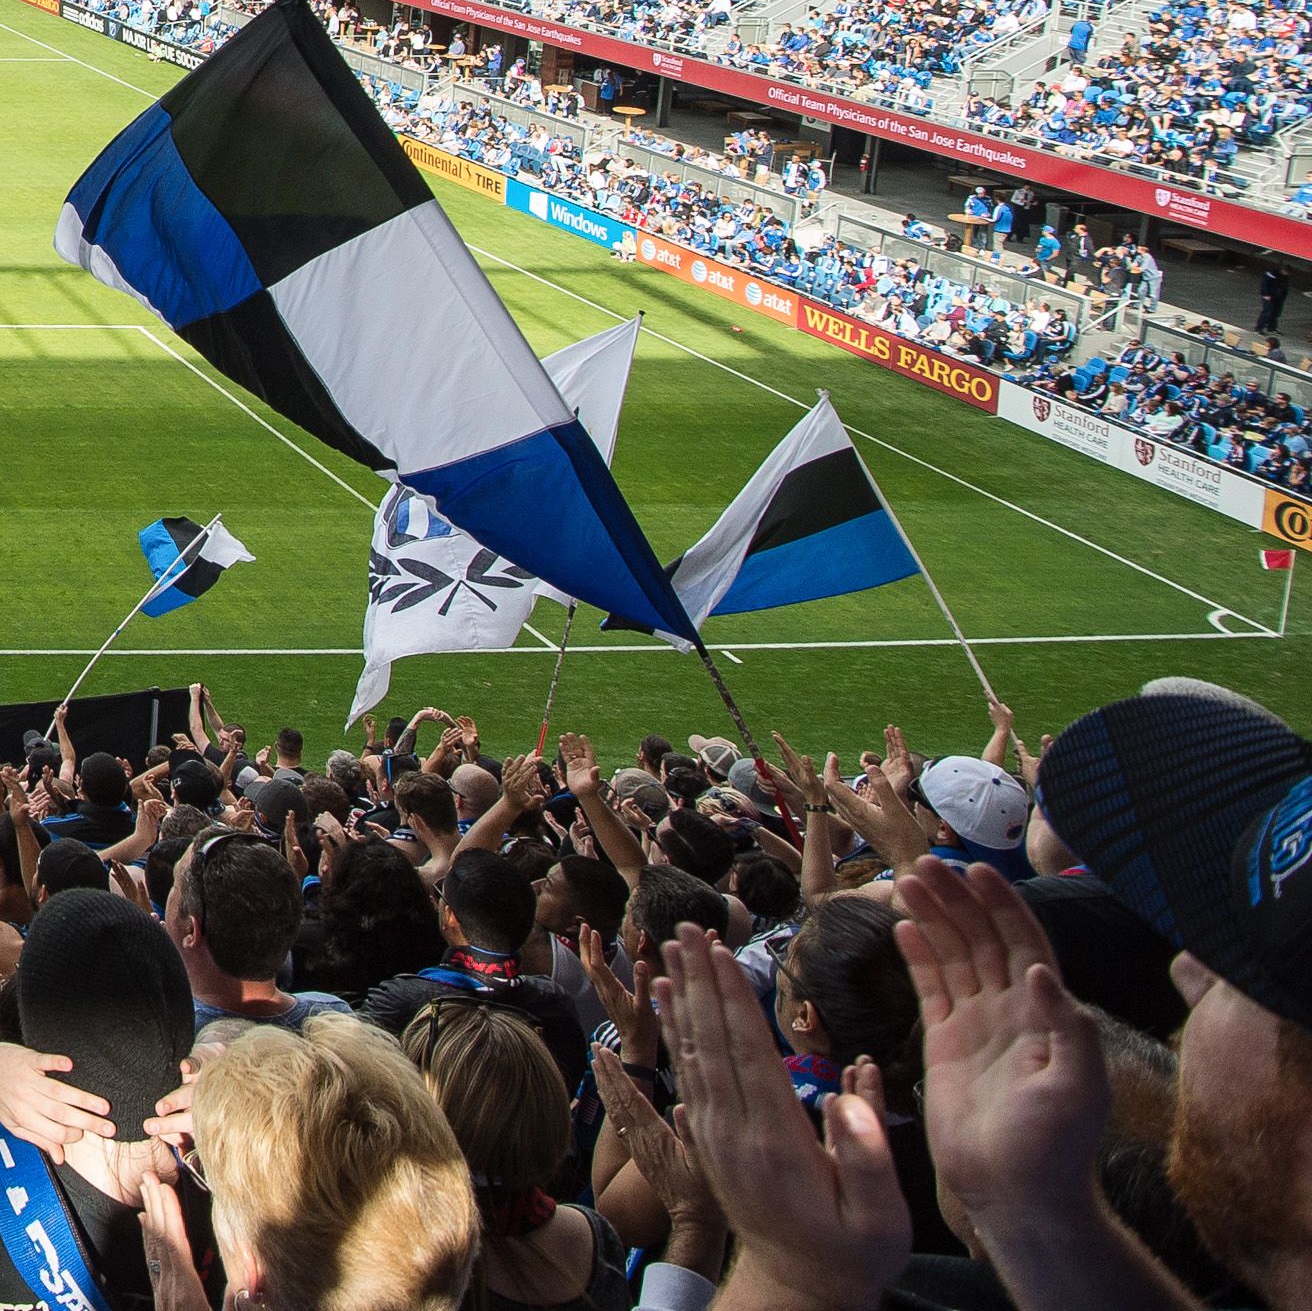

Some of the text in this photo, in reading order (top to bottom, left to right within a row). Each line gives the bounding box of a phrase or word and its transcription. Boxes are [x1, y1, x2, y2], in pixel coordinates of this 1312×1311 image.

[78, 11, 105, 34] adidas
[450, 0, 466, 15] Team
[466, 5, 496, 25] Physicians
[496, 13, 504, 25] of
[503, 15, 514, 27] the
[514, 17, 526, 31] San
[526, 21, 541, 35] Jose
[541, 26, 582, 47] Earthquakes
[122, 27, 147, 51] MAJOR
[768, 86, 1027, 169] Official Team Physicians of the San Jose Earthquakes
[475, 172, 502, 195] TIRE
[550, 201, 608, 241] Windows
[657, 247, 682, 270] at&t
[708, 269, 735, 293] at&t
[763, 291, 792, 316] at&t
[803, 304, 993, 403] WELLS FARGO
[1053, 419, 1109, 450] HEALTH CARE
[1054, 404, 1109, 438] Stanford
[1157, 463, 1220, 497] HEALTH CARE
[1159, 447, 1222, 485] Stanford
